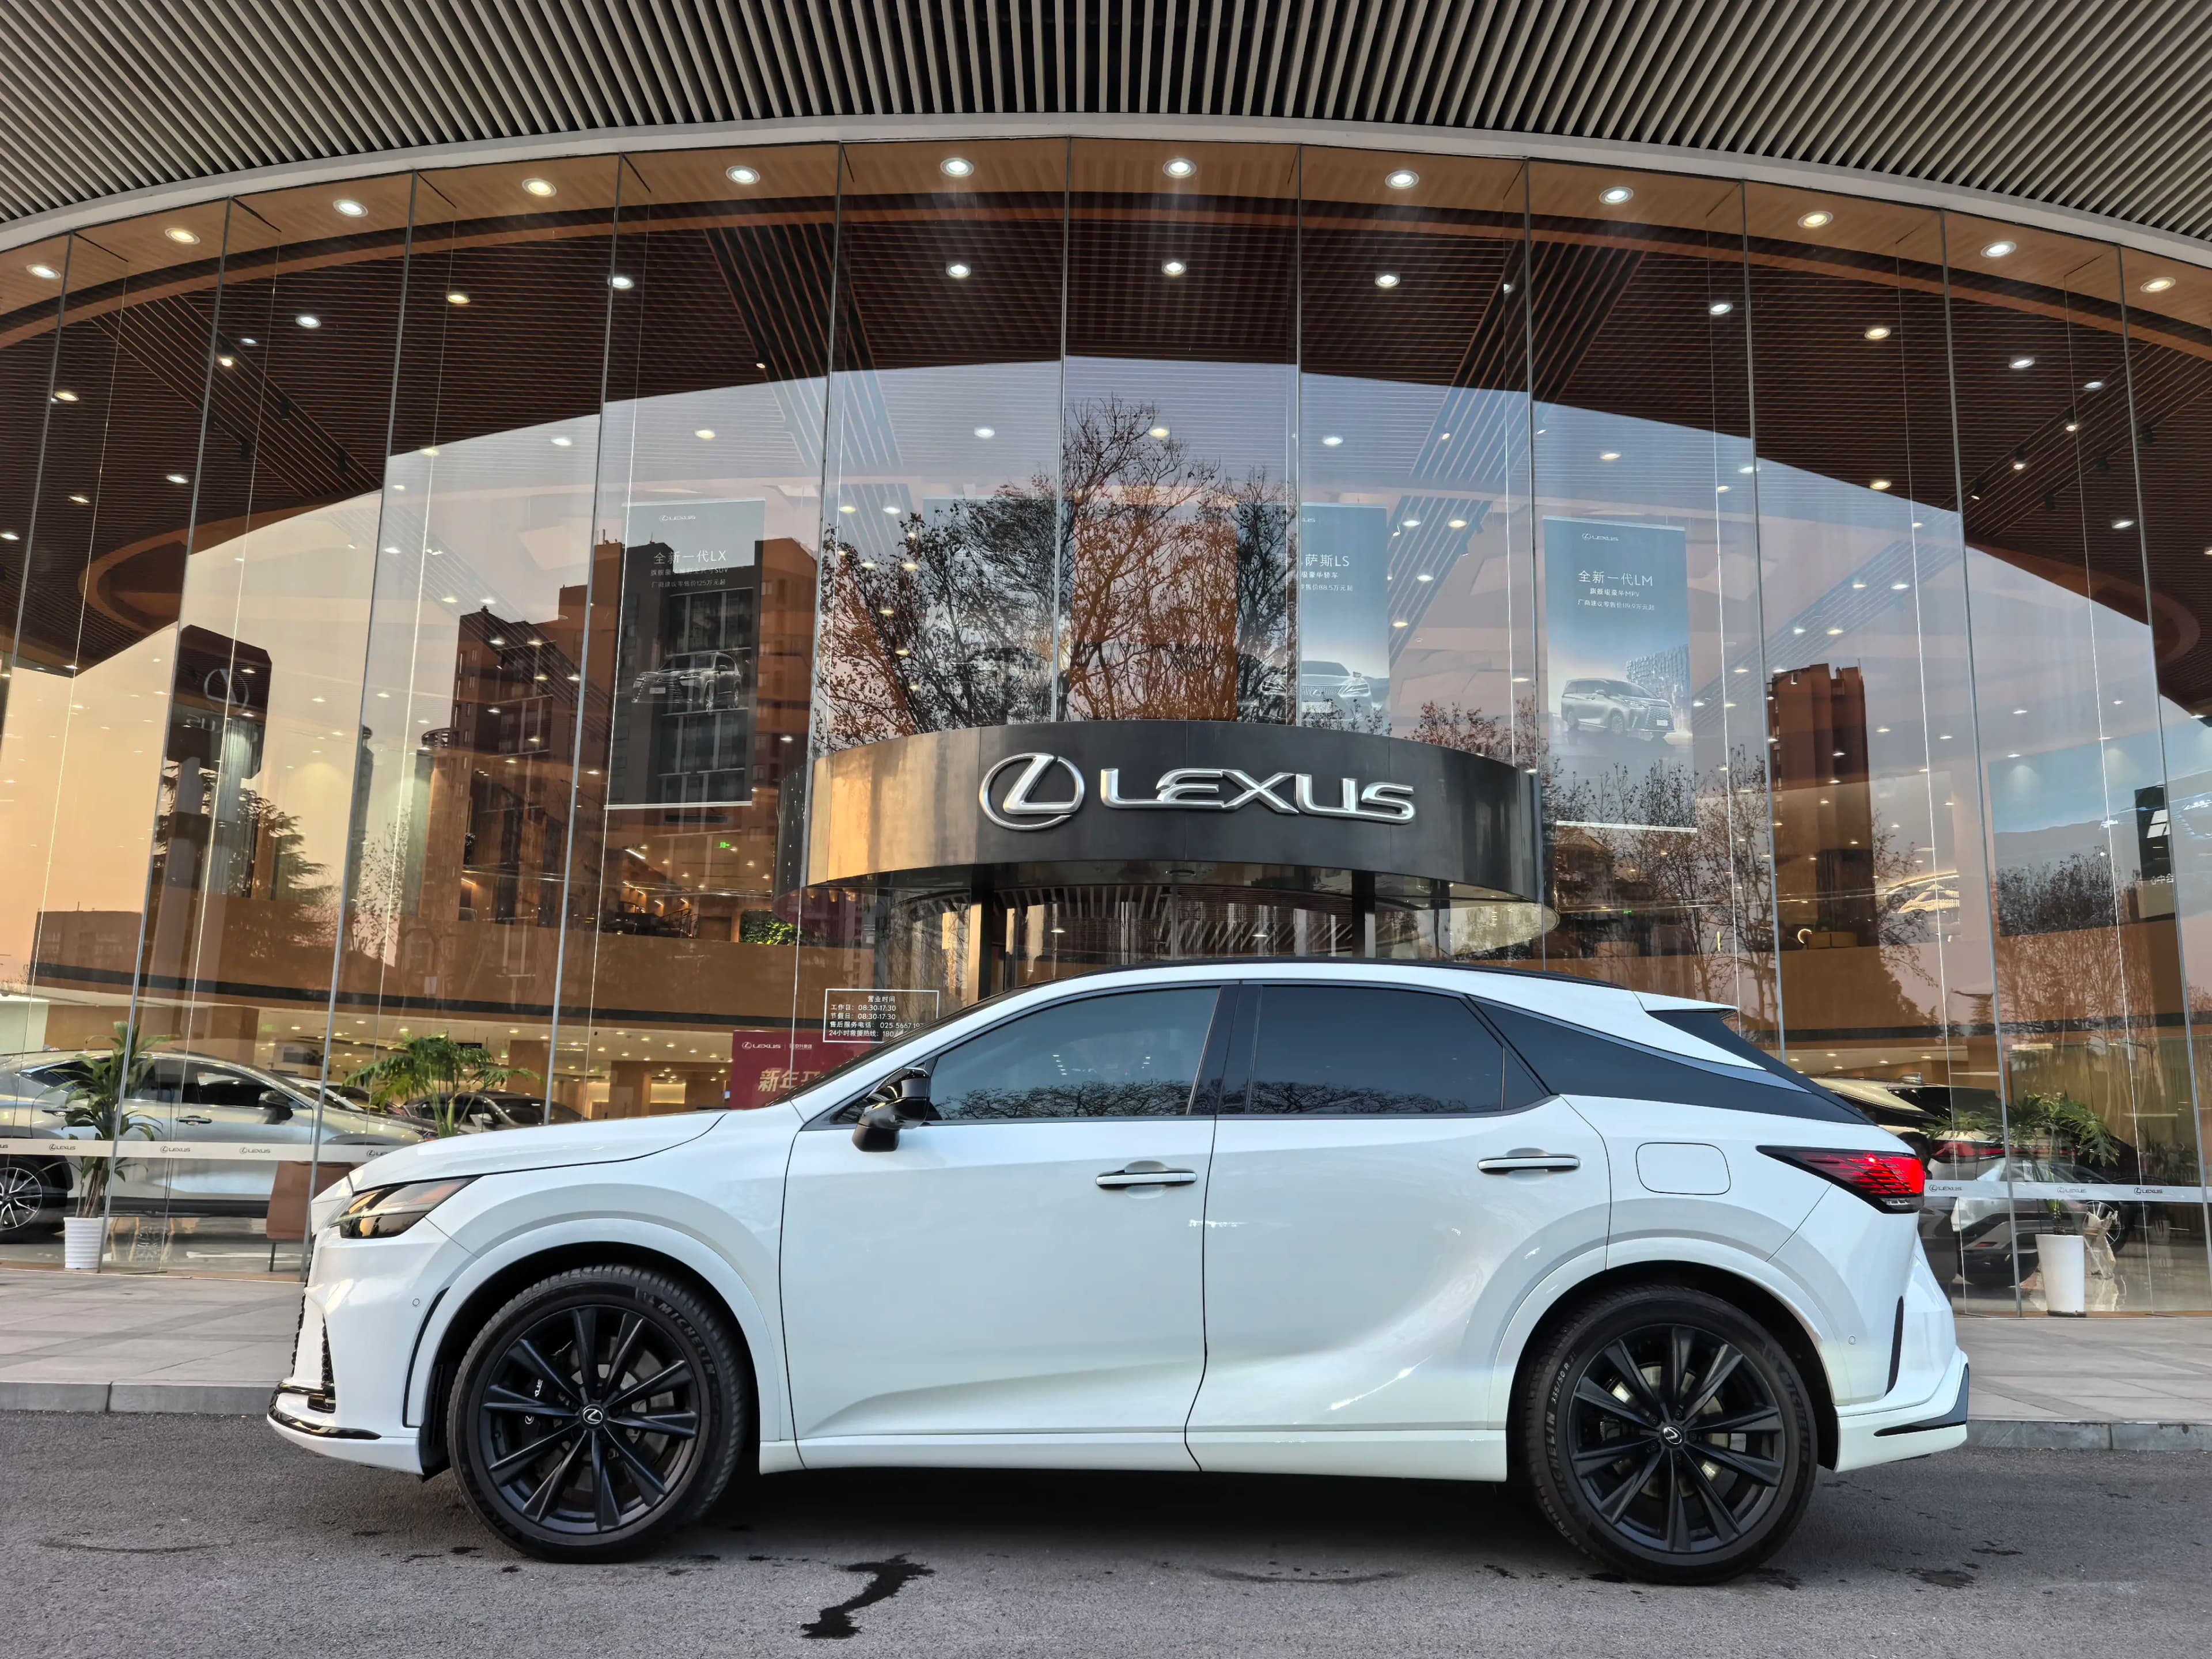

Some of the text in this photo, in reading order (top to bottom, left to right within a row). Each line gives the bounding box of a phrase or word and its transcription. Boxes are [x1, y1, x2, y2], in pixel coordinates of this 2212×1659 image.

[653, 550, 726, 565] 全新一代LX
[1578, 570, 1653, 586] 全新一代LM
[1100, 767, 1416, 824] LEXUS
[657, 1302, 715, 1374] MICHELIN
